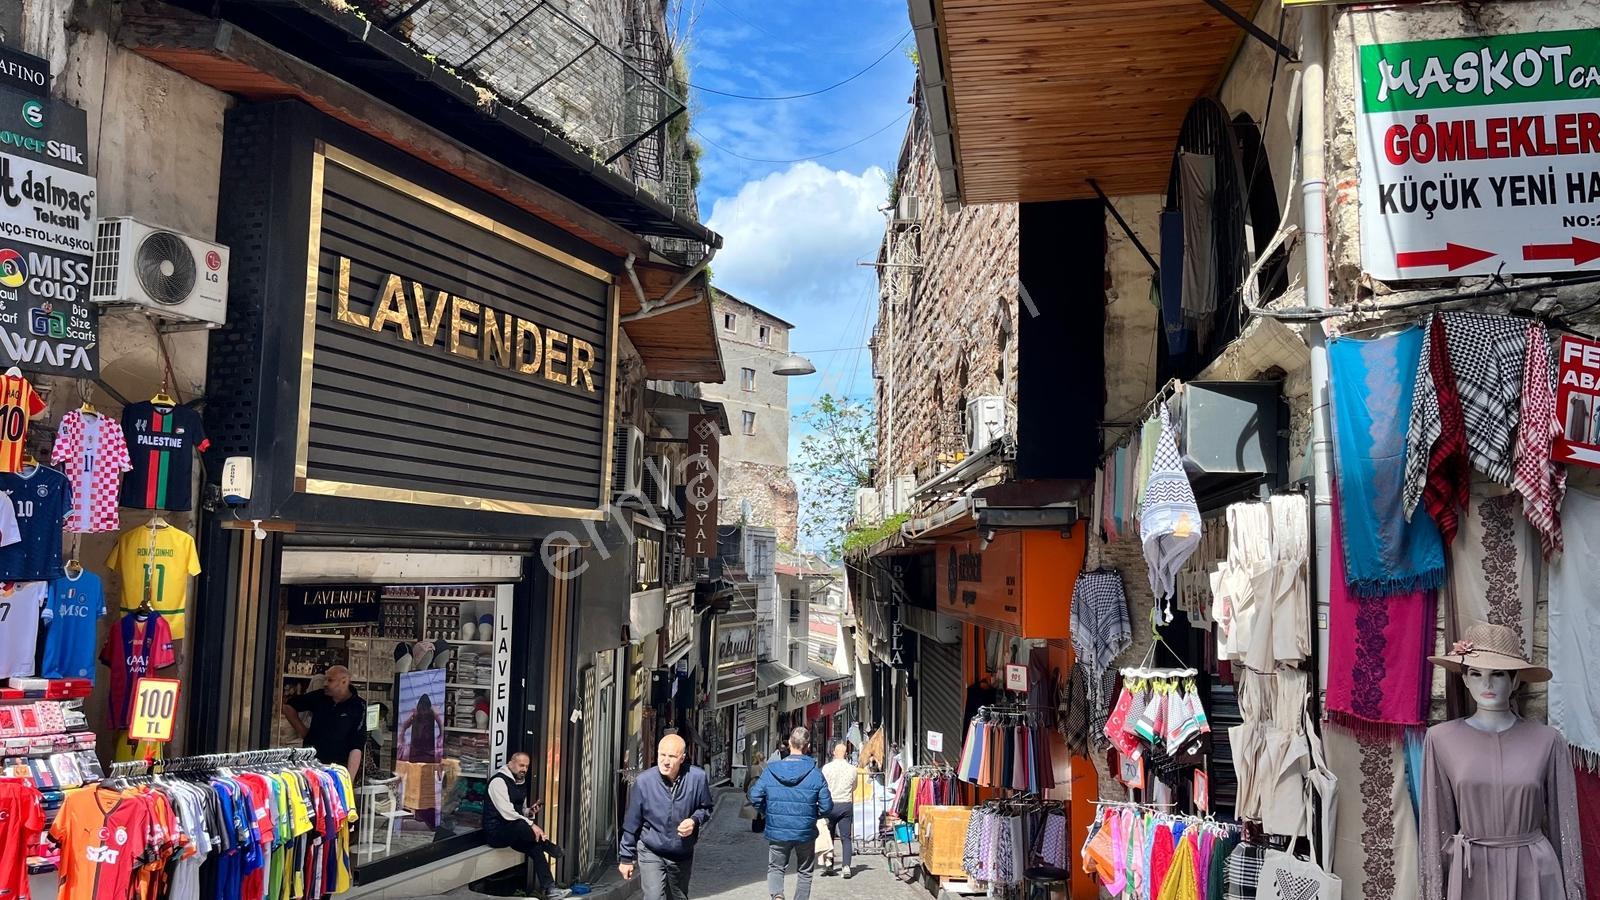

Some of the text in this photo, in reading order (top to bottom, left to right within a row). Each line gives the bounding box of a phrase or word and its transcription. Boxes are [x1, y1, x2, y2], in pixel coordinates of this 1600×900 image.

[1377, 46, 1571, 102] MASKOT
[1379, 175, 1482, 220] KÜÇÜK
[1488, 166, 1557, 208] YENİ
[33, 206, 79, 230] Tekstil
[29, 252, 89, 285] MISS
[206, 272, 218, 283] LG
[29, 277, 79, 302] COLO
[72, 304, 88, 319] Big
[70, 316, 91, 330] Size
[331, 256, 596, 393] LAVENDER
[66, 328, 96, 342] Scarfs
[137, 434, 182, 448] PALESTINE
[17, 500, 33, 517] 10
[303, 590, 376, 605] LAVENDER
[494, 615, 508, 770] LAVENDE
[140, 689, 174, 718] 100
[147, 721, 161, 734] TL
